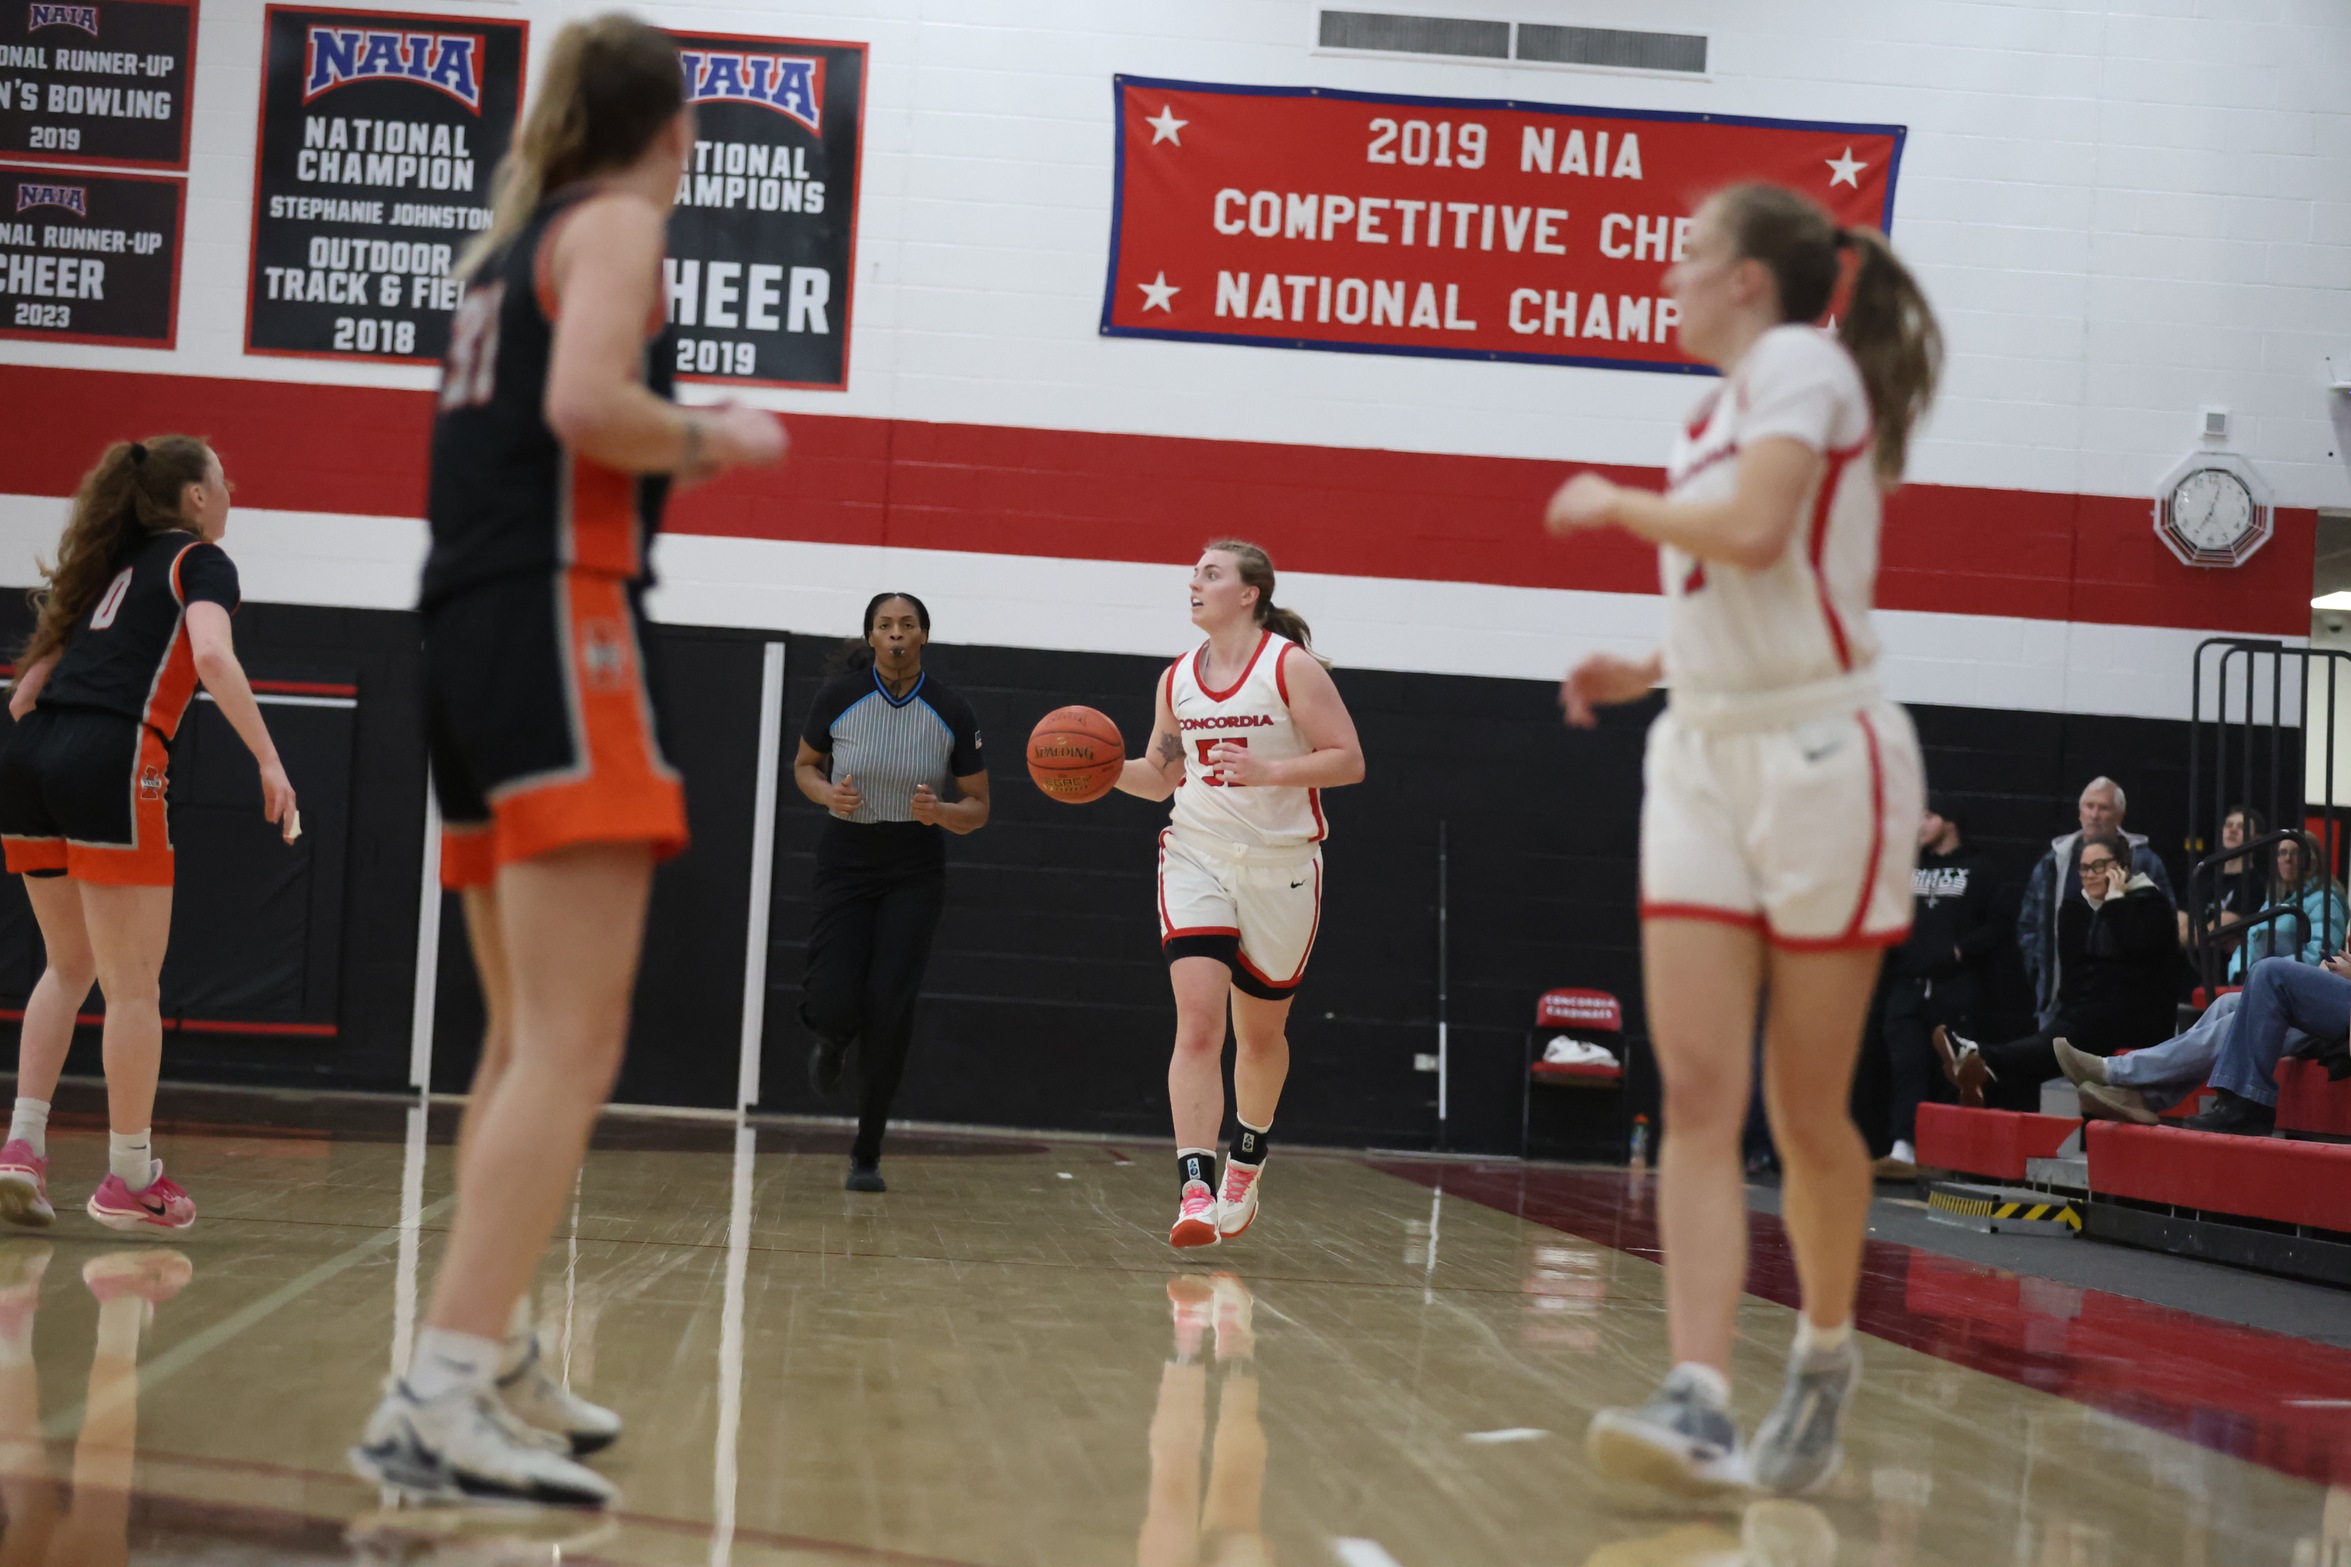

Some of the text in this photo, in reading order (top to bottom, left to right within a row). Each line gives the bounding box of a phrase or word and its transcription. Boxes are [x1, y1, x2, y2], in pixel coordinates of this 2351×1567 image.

[29, 3, 98, 36] NAIA
[55, 49, 174, 77] RUNNER-UP
[306, 27, 480, 107] NAIA
[48, 84, 172, 120] BOWLING
[29, 126, 81, 150] 2019
[304, 116, 470, 158] NATIONAL
[1367, 117, 1643, 180] 2019 NAIA
[297, 149, 475, 192] CHAMPION
[683, 140, 810, 180] TIONAL
[16, 183, 87, 217] NAIA
[269, 195, 494, 231] STEPHANIE JOHNSTON
[43, 225, 163, 255] RUNNER-UP
[1213, 188, 1569, 255] COMPETITIVE
[308, 236, 452, 277] OUTDOOR
[264, 266, 370, 305] TRACK
[379, 274, 402, 308] &
[1214, 270, 1477, 331] NATIONAL
[15, 303, 71, 328] 2023
[333, 317, 416, 354] 2018
[676, 338, 756, 375] 2019
[1179, 714, 1275, 730] CONCORDIA
[1035, 745, 1094, 760] SPALDING
[1195, 737, 1248, 788] 5
[1545, 994, 1616, 1008] CONCORDIA
